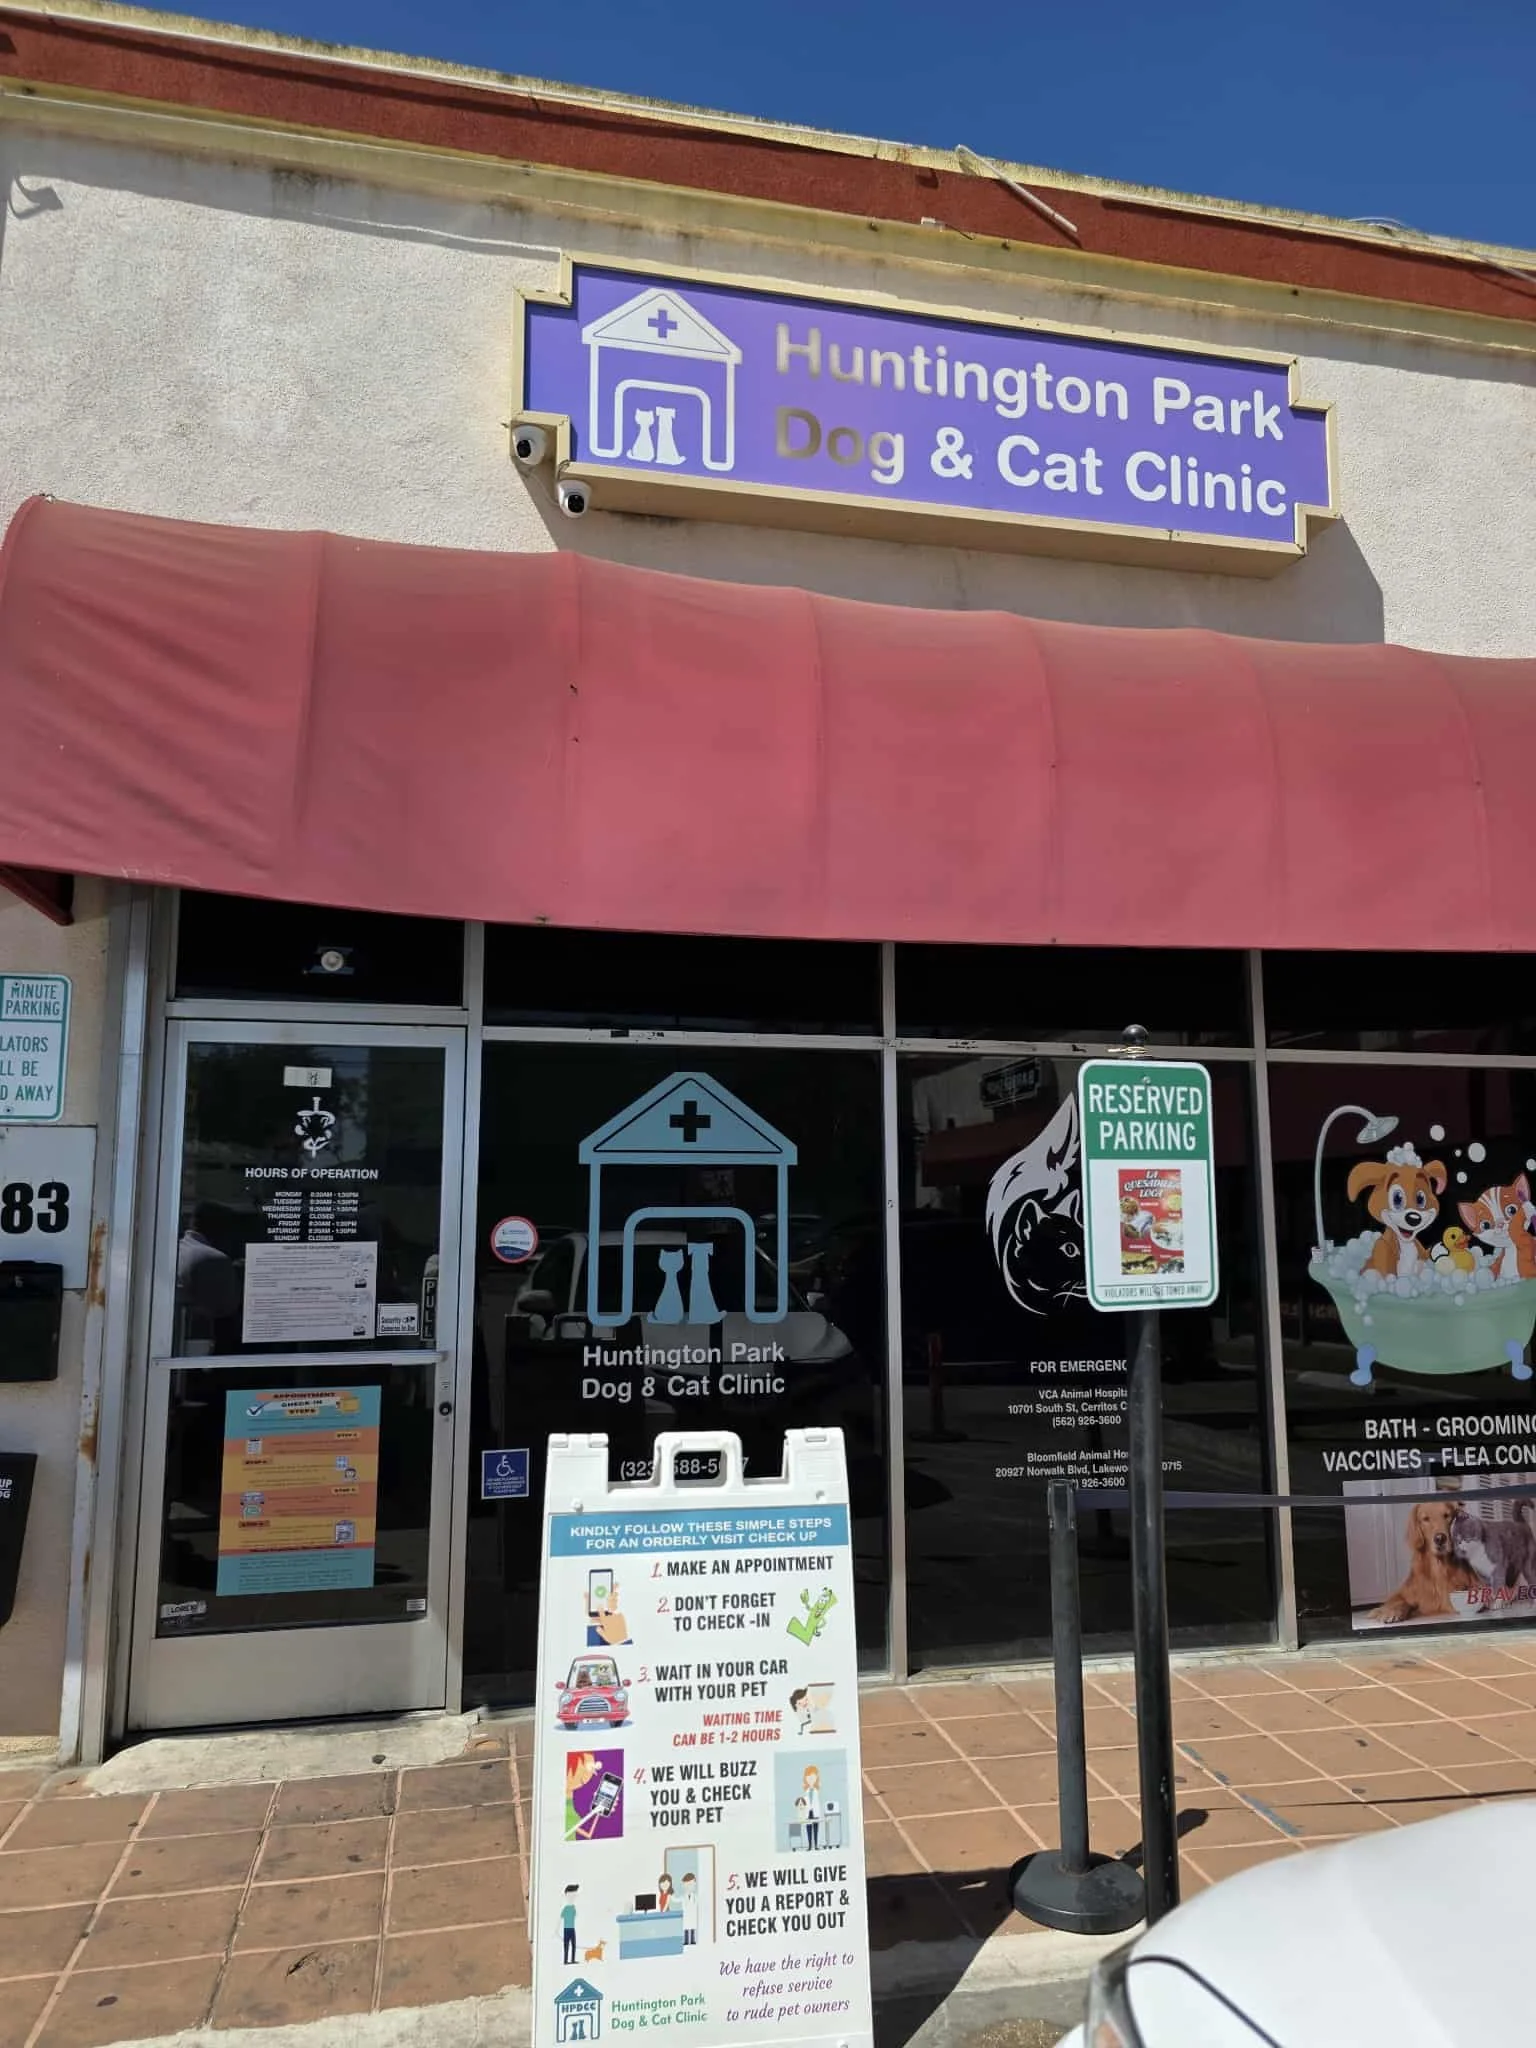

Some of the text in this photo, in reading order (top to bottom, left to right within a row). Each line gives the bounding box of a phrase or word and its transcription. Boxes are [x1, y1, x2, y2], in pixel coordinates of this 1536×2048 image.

[775, 321, 1286, 443] Huntington Park
[774, 406, 1289, 518] Dog & Cat Clinic
[11, 984, 57, 1000] MINUTE
[5, 1000, 60, 1016] PARKING
[0, 1036, 48, 1052] LATORS
[22, 1061, 39, 1077] BE
[15, 1085, 53, 1101] AWAY
[1088, 1084, 1203, 1115] RESERVED
[1100, 1121, 1197, 1151] PARKING
[245, 1168, 379, 1179] HOURS OF OPERATION
[1, 1182, 69, 1234] 83
[425, 1281, 435, 1337] PULL
[583, 1341, 785, 1368] Huntington Park
[1030, 1361, 1057, 1373] FOR
[582, 1373, 785, 1404] Dog & Cat Clinic
[1039, 1390, 1058, 1399] VCA
[1060, 1389, 1092, 1399] Animal
[1008, 1404, 1034, 1414] 10701
[1035, 1403, 1063, 1413] South
[1081, 1401, 1118, 1412] Cerritos
[1052, 1415, 1122, 1428] (562) 926-3600
[1365, 1418, 1417, 1439] BATH
[1027, 1451, 1077, 1462] Bloomfield
[1079, 1450, 1111, 1461] Animal
[1322, 1449, 1422, 1472] VACCINES
[1441, 1446, 1490, 1468] FLEA
[995, 1467, 1024, 1477] 20927
[1027, 1466, 1065, 1476] Norwalk
[1092, 1463, 1128, 1474] Lakewo
[1161, 1461, 1183, 1471] 0715
[1081, 1477, 1125, 1488] 926-3600
[570, 1517, 832, 1537] KINDLY FOLLOW THESE SIMPLE STEPS
[586, 1531, 817, 1549] FOR AN ORDERLY VISIT CHECK UP
[650, 1555, 834, 1578] 1. MAKE AN APPOINTMENT
[657, 1592, 776, 1613] 2. DON'T FORGET
[674, 1616, 692, 1632] TO
[696, 1614, 745, 1630] CHECK
[637, 1659, 788, 1682] 3. WAIT IN YOUR CAR
[655, 1681, 768, 1702] WITH YOUR PET
[702, 1710, 784, 1727] WAITING TIME
[672, 1729, 781, 1746] CAN BE 1-2 HOURS
[633, 1760, 757, 1785] 4. WE WILL BUZZ
[650, 1783, 752, 1806] YOU & CHECK
[650, 1806, 724, 1827] YOUR PET
[727, 1865, 847, 1890] 5. WE WILL GIVE
[726, 1889, 850, 1914] YOU A REPORT &
[726, 1912, 846, 1937] CHECK YOU OUT
[719, 1952, 855, 1976] We have the right to
[742, 1978, 833, 1998] refuse service
[561, 2002, 596, 2013] HPDCC
[611, 1993, 706, 2012] Huntington Park
[726, 1999, 850, 2023] to rude pet owners
[611, 2010, 708, 2031] Dog & Cat Clinic
